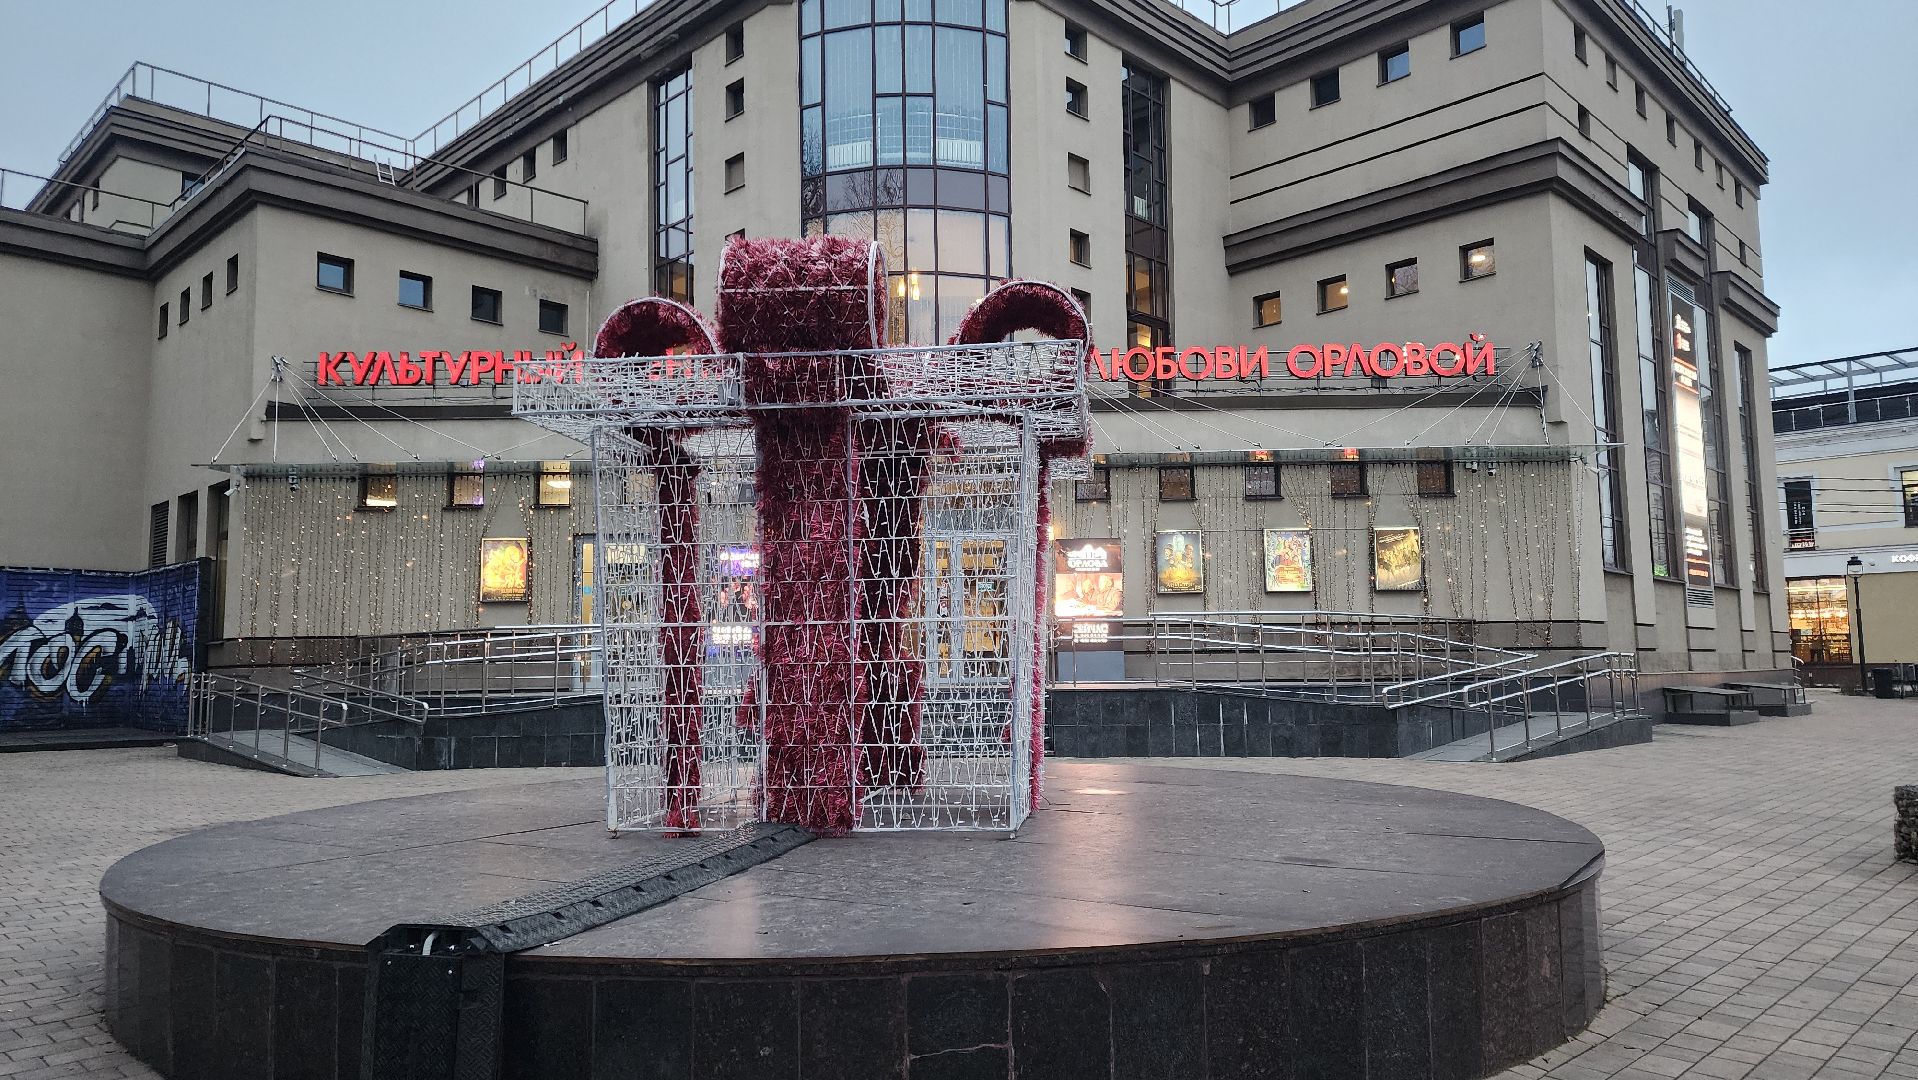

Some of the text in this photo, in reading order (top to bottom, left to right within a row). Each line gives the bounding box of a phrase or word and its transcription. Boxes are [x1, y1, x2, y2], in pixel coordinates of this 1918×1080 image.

[317, 341, 585, 386] КУЛЬТУРНЫЙ
[1090, 343, 1268, 381] ЛЮБОВИ
[1286, 333, 1496, 380] ОРЛОВОЙ
